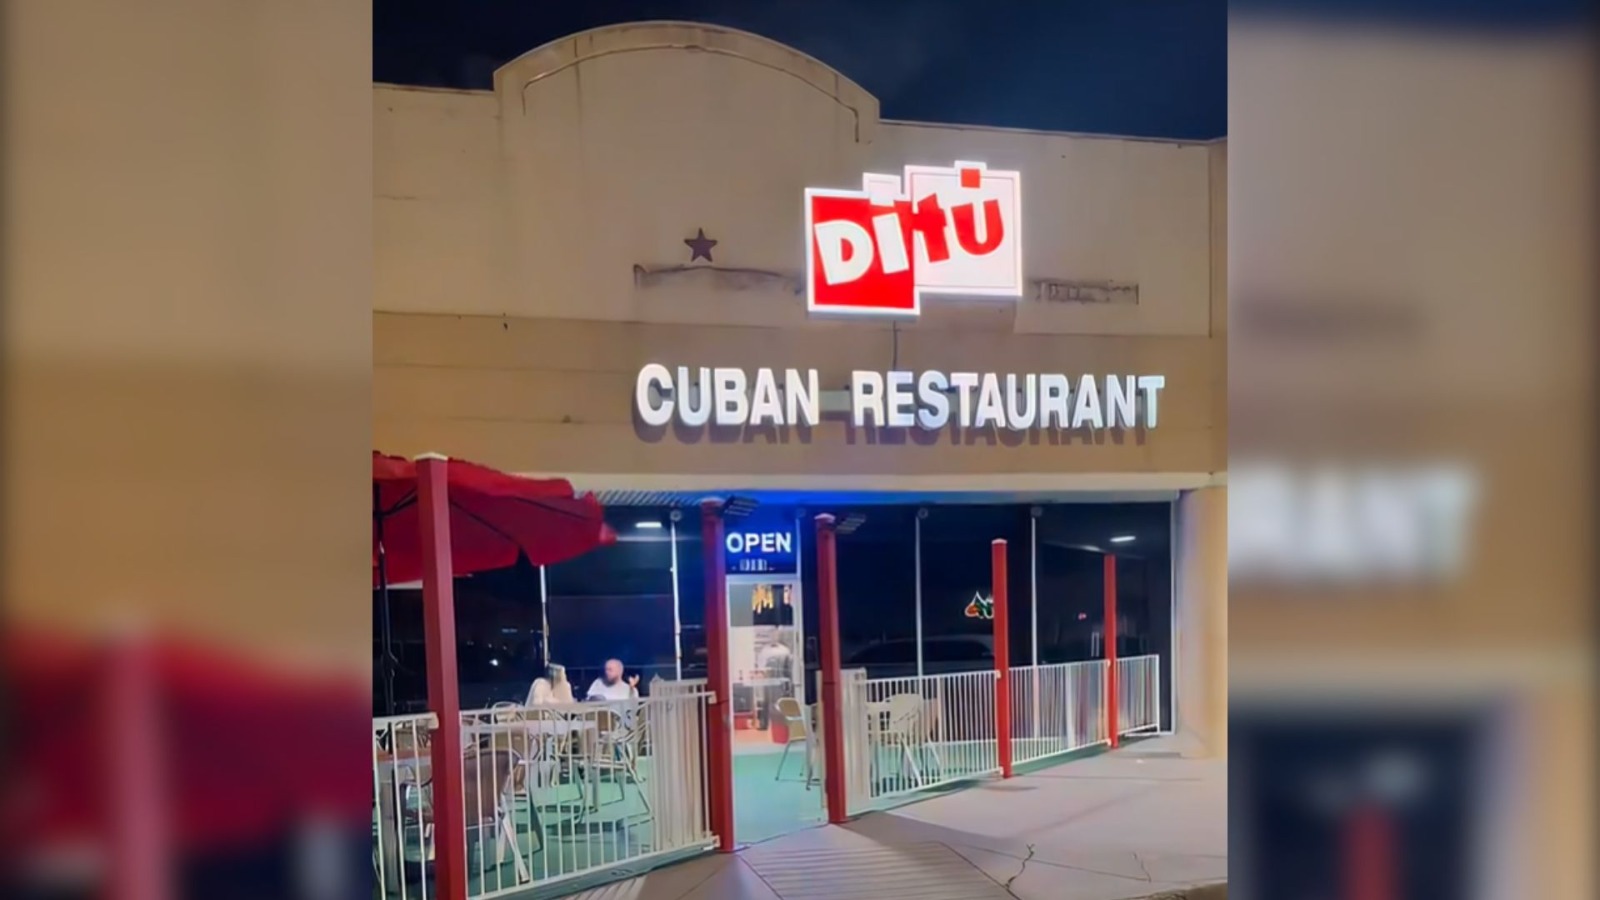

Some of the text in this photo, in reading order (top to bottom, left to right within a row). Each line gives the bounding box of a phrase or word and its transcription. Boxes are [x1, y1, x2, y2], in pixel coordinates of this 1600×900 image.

[636, 363, 1165, 431] CUBAN RESTAURANT
[726, 531, 792, 553] OPEN
